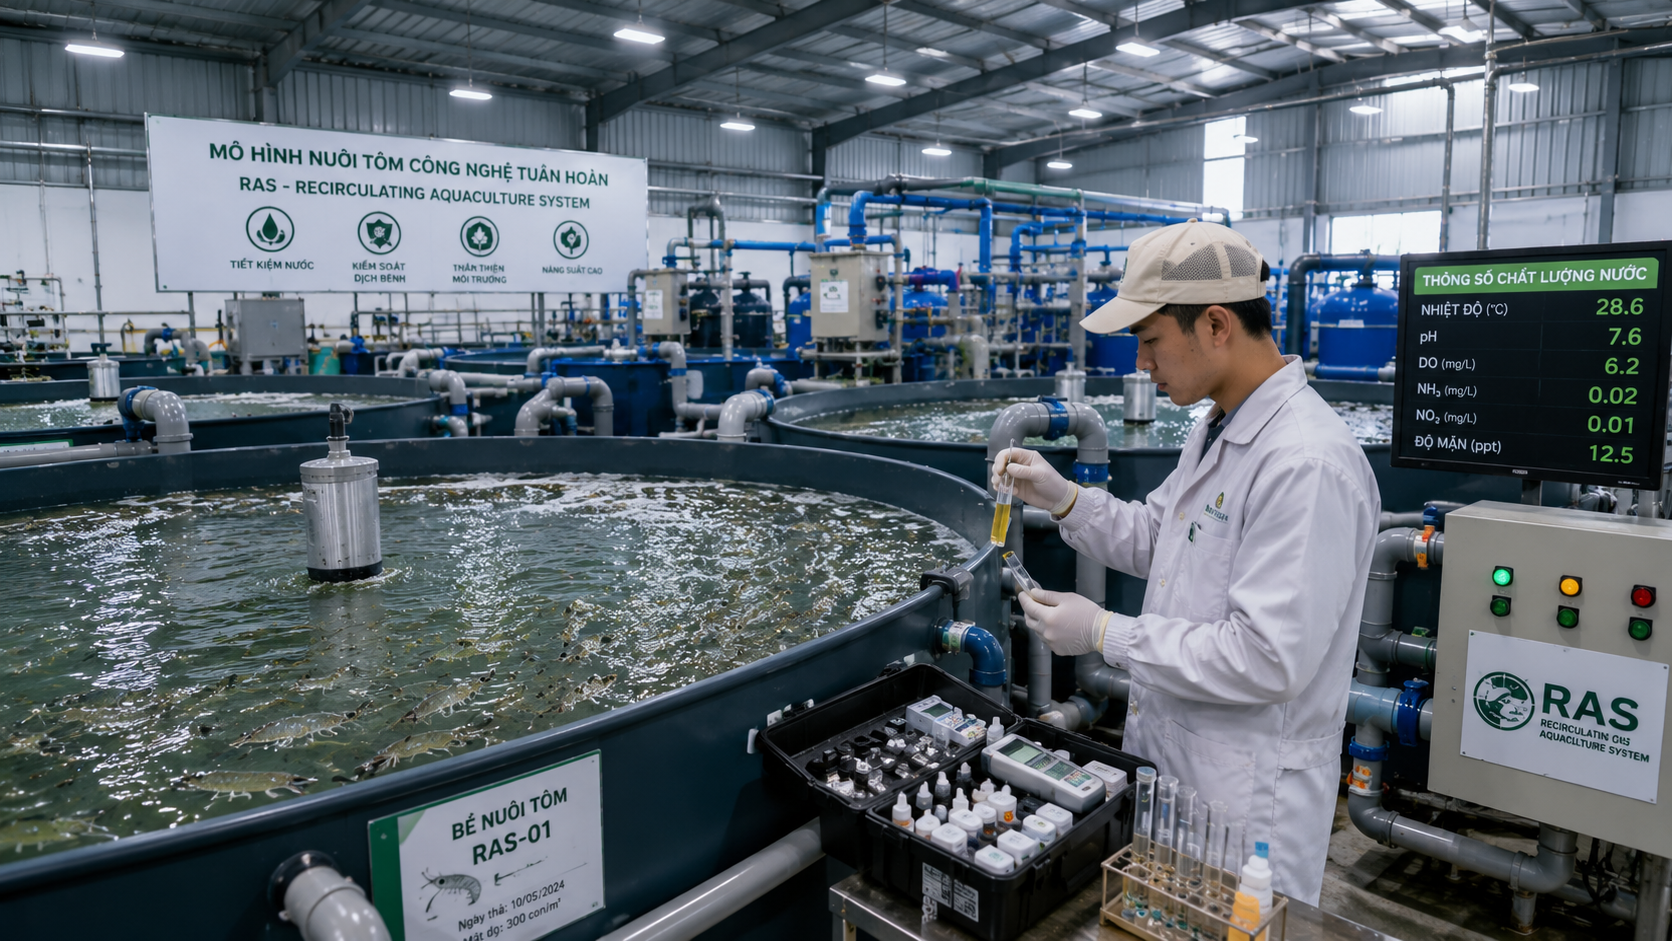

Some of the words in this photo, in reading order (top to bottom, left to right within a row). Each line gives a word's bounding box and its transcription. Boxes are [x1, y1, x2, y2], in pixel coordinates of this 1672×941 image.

[209, 140, 244, 161] MÔ
[251, 142, 302, 165] HÌNH
[309, 148, 357, 169] NUÔI
[362, 151, 404, 172] TÔM
[409, 154, 461, 176] CÔNG
[466, 162, 513, 183] NGHỆ
[565, 169, 609, 187] HOÀN
[239, 176, 277, 192] RAS
[295, 180, 425, 200] RECIRCULATING
[430, 188, 535, 206] AQUACULTURE
[539, 195, 590, 209] SYSTEM
[587, 266, 603, 275] CAO
[1421, 301, 1460, 318] NHIỆT
[1463, 301, 1483, 318] ĐỘ
[1595, 297, 1644, 316] 28.6
[1419, 330, 1437, 344] pH
[1608, 327, 1642, 346] 7.6
[1418, 357, 1438, 369] DO
[1441, 358, 1476, 371] (mg/L)
[1604, 357, 1640, 375] 6.2
[1444, 385, 1478, 398] (mg/L)
[1588, 386, 1638, 405] 0.02
[1444, 412, 1477, 425] (mg/L)
[1587, 415, 1634, 434] 0.01
[1414, 434, 1433, 450] ĐỘ
[1470, 440, 1502, 454] (ppt)
[1589, 444, 1634, 464] 12.5
[1541, 683, 1639, 732] RAS
[1608, 745, 1650, 763] SYSTEM
[481, 799, 525, 832] NUÔI
[530, 787, 568, 813] TÔM
[472, 820, 551, 865] RAS-01
[511, 879, 565, 909] 10/05/2024
[506, 912, 526, 930] 300
